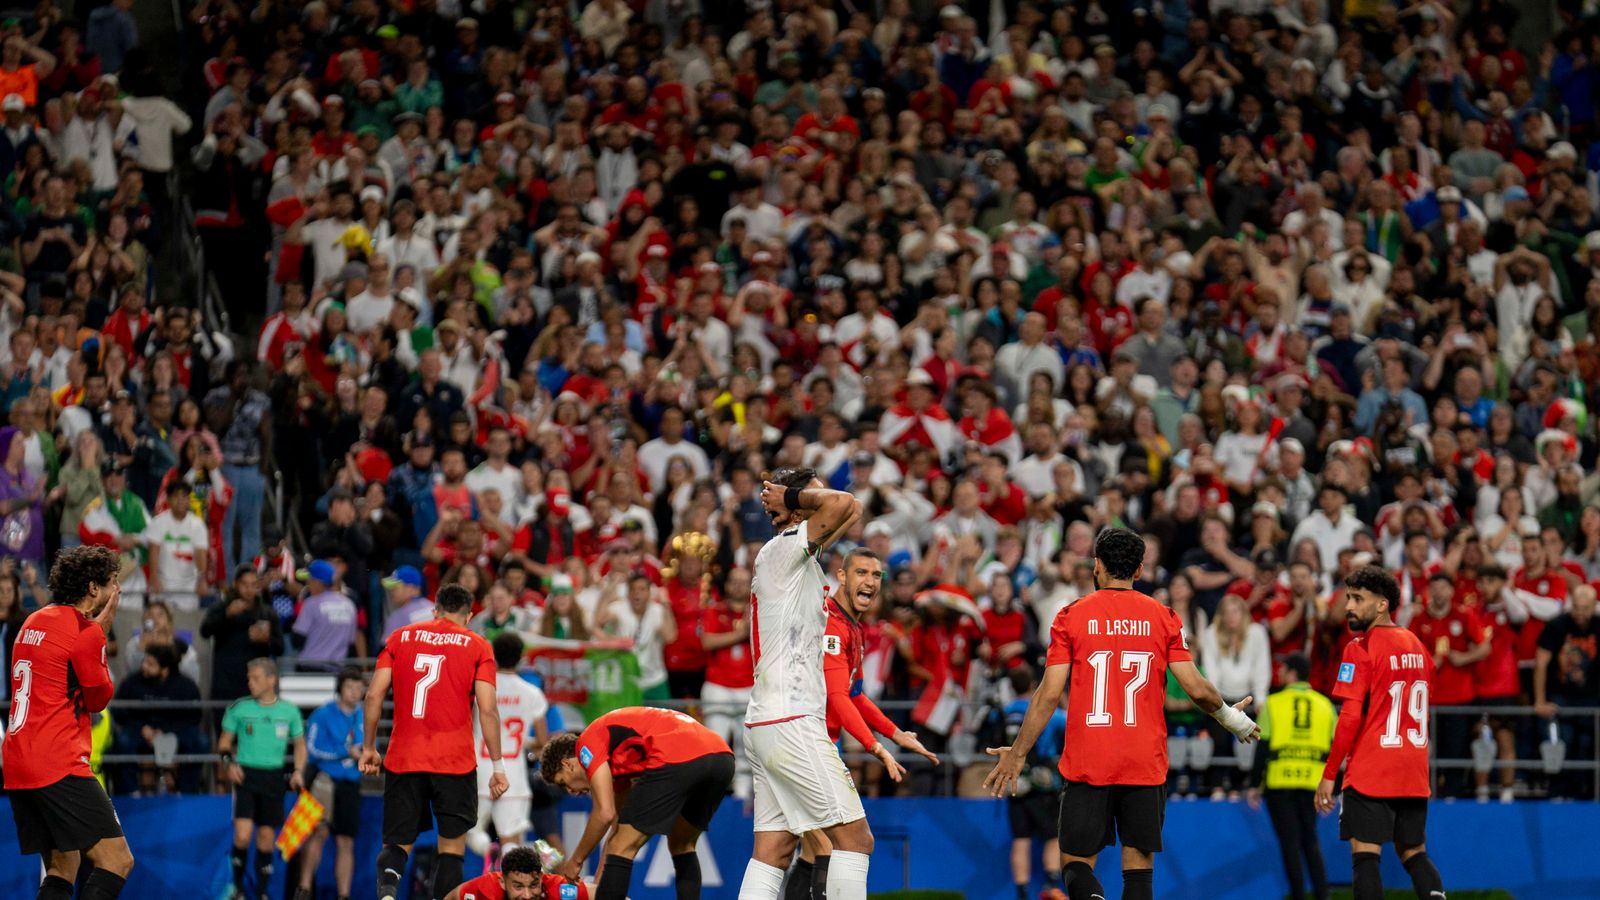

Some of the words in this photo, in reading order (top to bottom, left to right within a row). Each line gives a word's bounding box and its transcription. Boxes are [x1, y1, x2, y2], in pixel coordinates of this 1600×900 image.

[22, 629, 46, 647] HANY
[401, 630, 410, 643] M.
[415, 630, 472, 647] TREZEGUET
[1088, 619, 1102, 635] M.
[1106, 619, 1151, 636] LASHIN
[1389, 655, 1400, 671] M.
[1401, 653, 1424, 669] ATTIA
[9, 659, 32, 735] 3
[413, 653, 446, 719] 7
[1086, 650, 1155, 727] 17
[1380, 680, 1429, 749] 19
